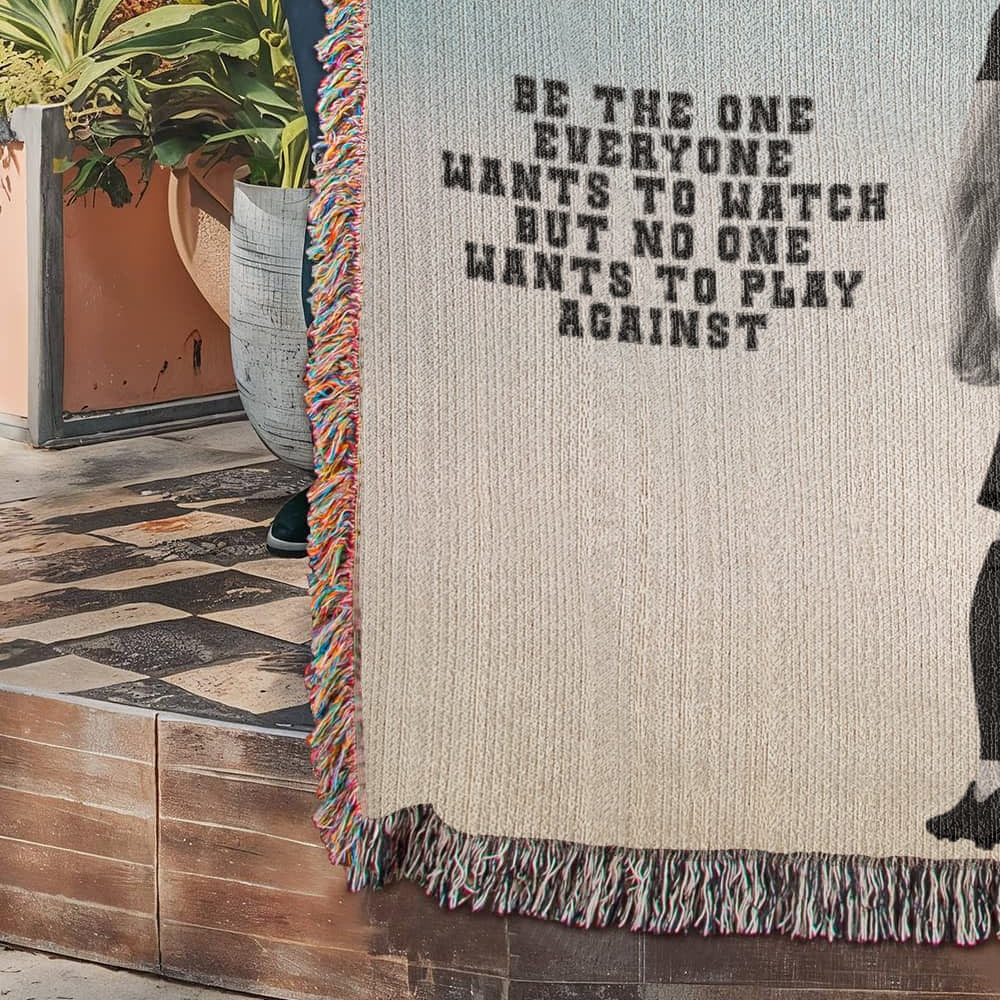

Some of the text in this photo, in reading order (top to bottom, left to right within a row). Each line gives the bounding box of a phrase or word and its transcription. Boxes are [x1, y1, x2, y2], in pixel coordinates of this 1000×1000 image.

[514, 74, 814, 134] BE THE ONE
[533, 121, 792, 178] EVERYONE
[441, 150, 888, 222] WANTS TO WATCH
[514, 205, 810, 265] BUT NO ONE
[464, 241, 863, 309] WANTS TO PLAY
[558, 299, 767, 351] AGAINST
